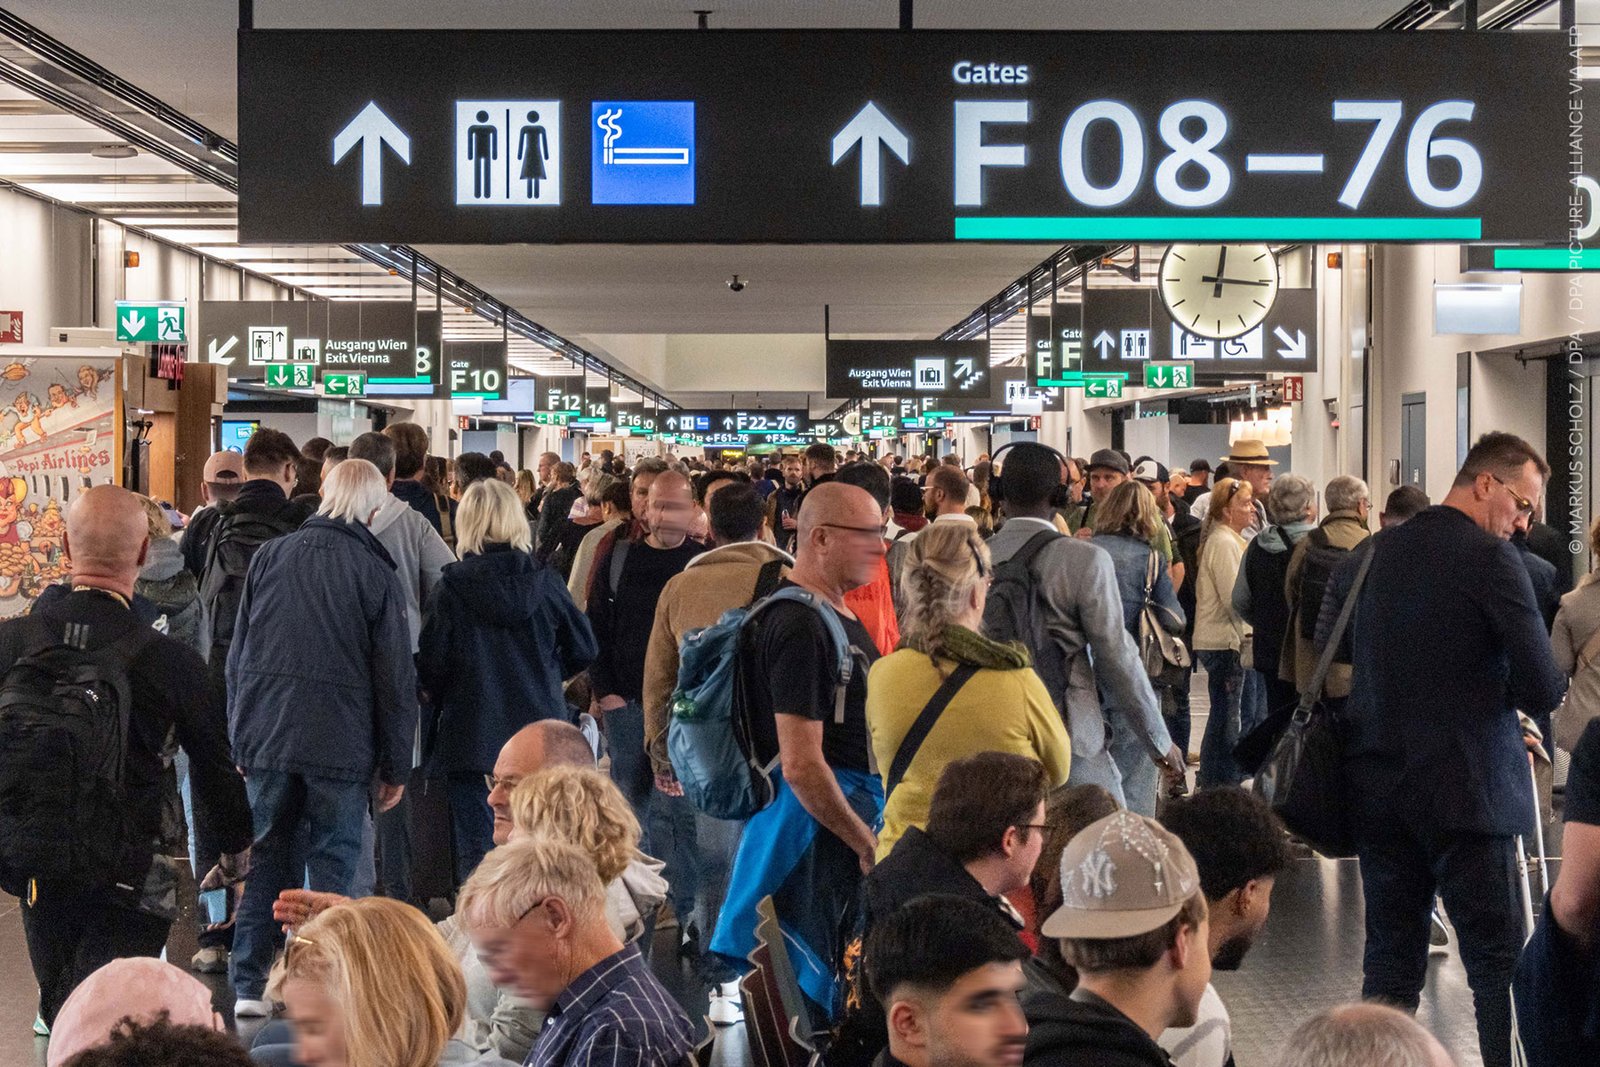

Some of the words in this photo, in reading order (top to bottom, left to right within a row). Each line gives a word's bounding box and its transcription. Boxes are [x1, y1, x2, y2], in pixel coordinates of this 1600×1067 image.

[953, 61, 1029, 84] Gates
[954, 100, 1029, 206] F
[325, 339, 376, 352] Ausgang
[377, 339, 408, 350] Wien
[325, 352, 348, 363] Exit
[349, 352, 390, 363] Vienna
[1062, 342, 1081, 369] F
[1037, 351, 1051, 376] F
[451, 370, 466, 391] F
[470, 369, 500, 391] 10
[848, 368, 887, 379] Ausgang
[888, 368, 911, 377] Wien
[862, 379, 880, 388] Exit
[880, 379, 911, 388] Vienna
[548, 395, 560, 410] F
[562, 395, 581, 410] 12
[589, 404, 607, 417] 14
[901, 404, 911, 417] F
[617, 416, 626, 426] F
[628, 415, 641, 426] 16
[737, 416, 748, 430] F
[873, 416, 881, 426] F
[882, 416, 895, 426] 17
[714, 433, 721, 442] F
[16, 457, 40, 474] Pepi
[41, 449, 110, 470] Airlines
